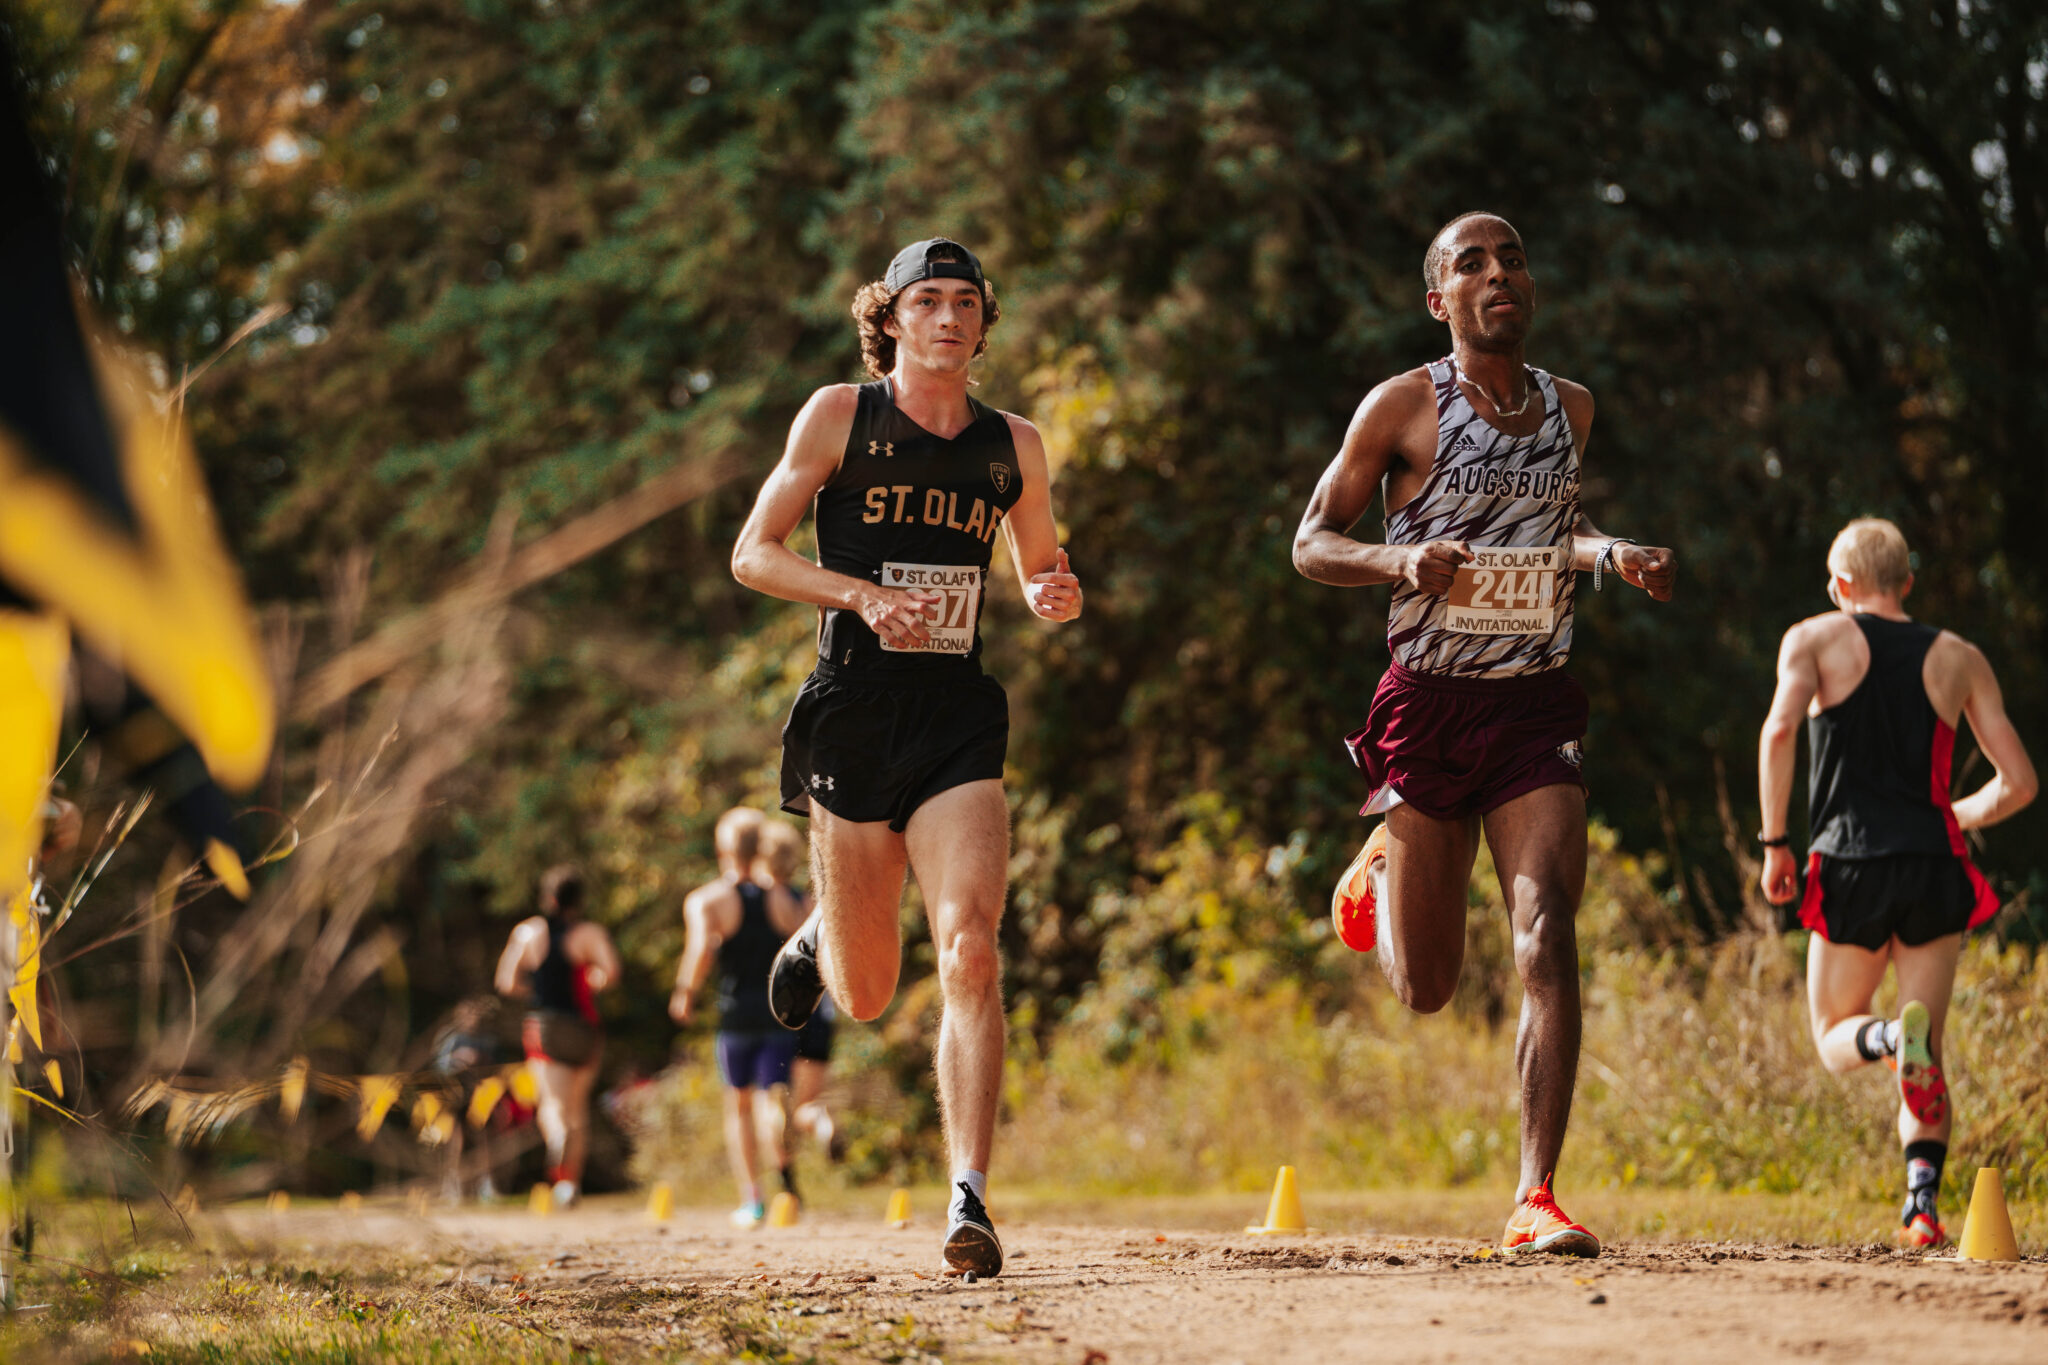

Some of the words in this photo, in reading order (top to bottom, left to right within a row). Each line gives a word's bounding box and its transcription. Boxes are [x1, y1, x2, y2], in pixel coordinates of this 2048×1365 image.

[1444, 466, 1573, 503] AUGSBURG
[862, 485, 915, 524] ST.
[1476, 552, 1498, 567] ST.
[1500, 553, 1541, 568] OLAF
[906, 569, 928, 585] ST.
[930, 571, 967, 586] OLAF
[1470, 570, 1540, 609] 244
[1455, 616, 1544, 632] INVITATIONAL
